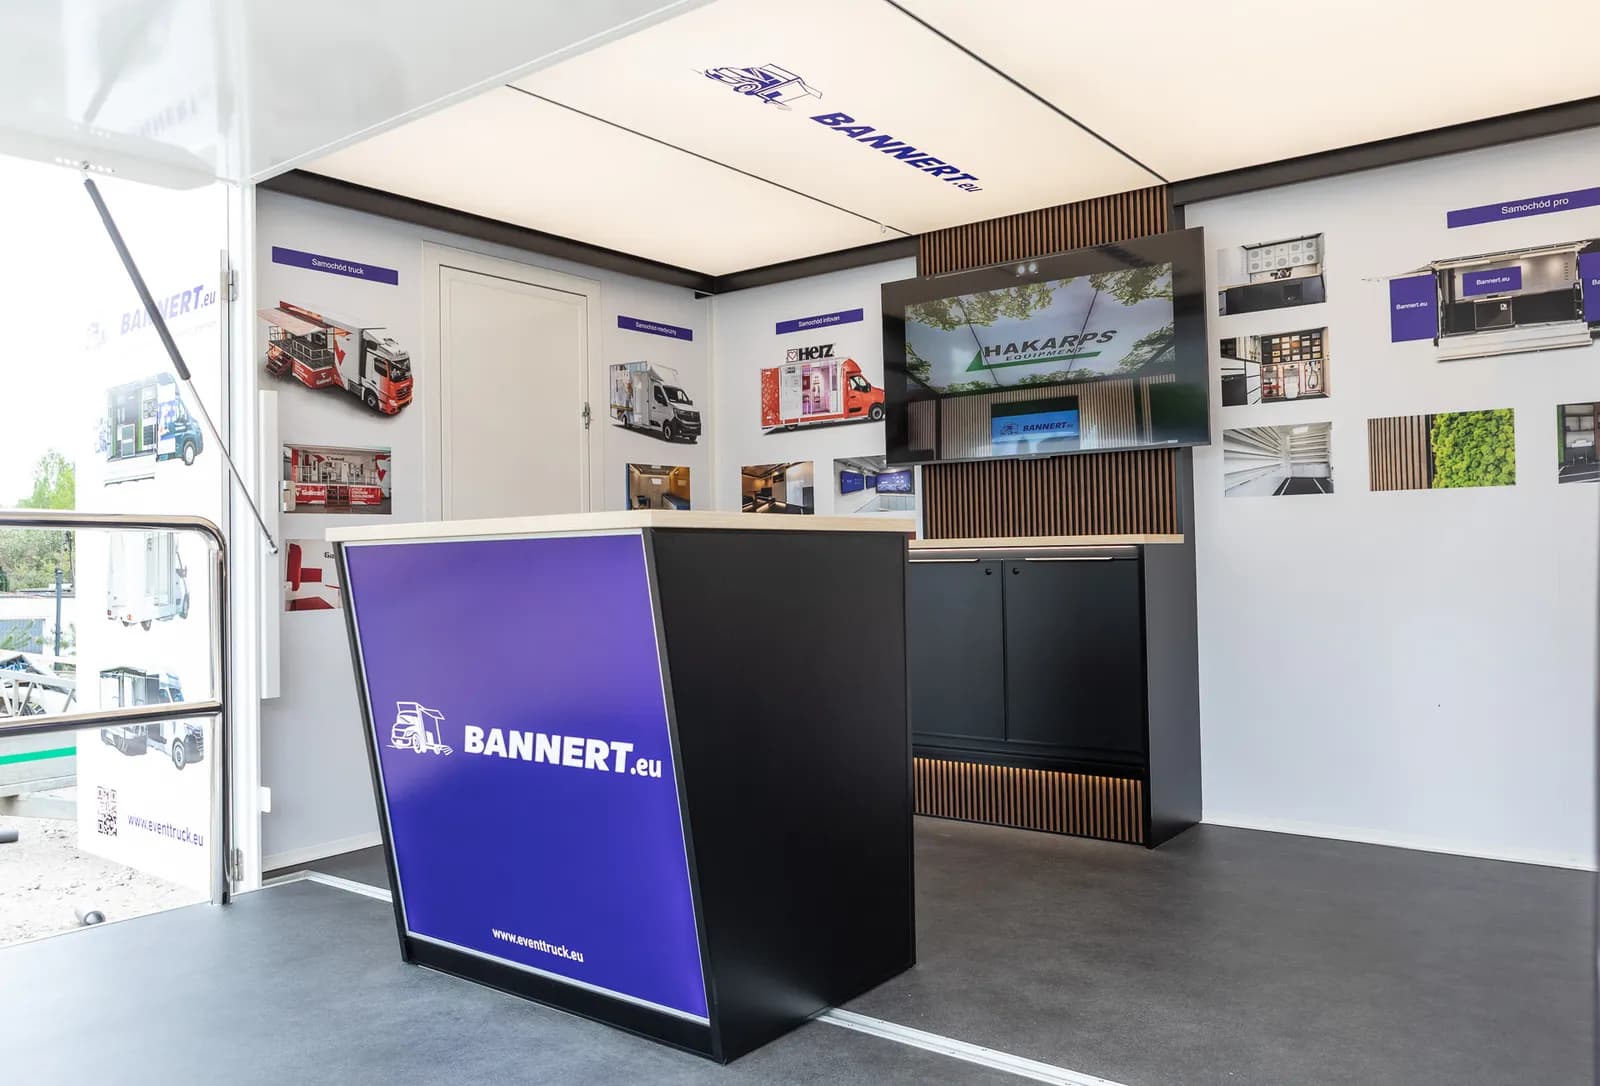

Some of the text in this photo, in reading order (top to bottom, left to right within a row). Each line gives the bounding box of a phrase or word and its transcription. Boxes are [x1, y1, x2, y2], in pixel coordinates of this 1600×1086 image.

[809, 112, 983, 192] BANNERT.eu
[1501, 198, 1569, 214] Samochód pro
[312, 258, 364, 275] Samochód truck
[1476, 276, 1510, 286] Bannert.eu
[984, 330, 1117, 357] HAKARPS
[1006, 346, 1086, 361] EQUIPMENT
[464, 725, 662, 778] BANNERT.eu
[127, 814, 204, 847] www.eventtruck.eu
[491, 927, 584, 963] www.eventtruck.eu
